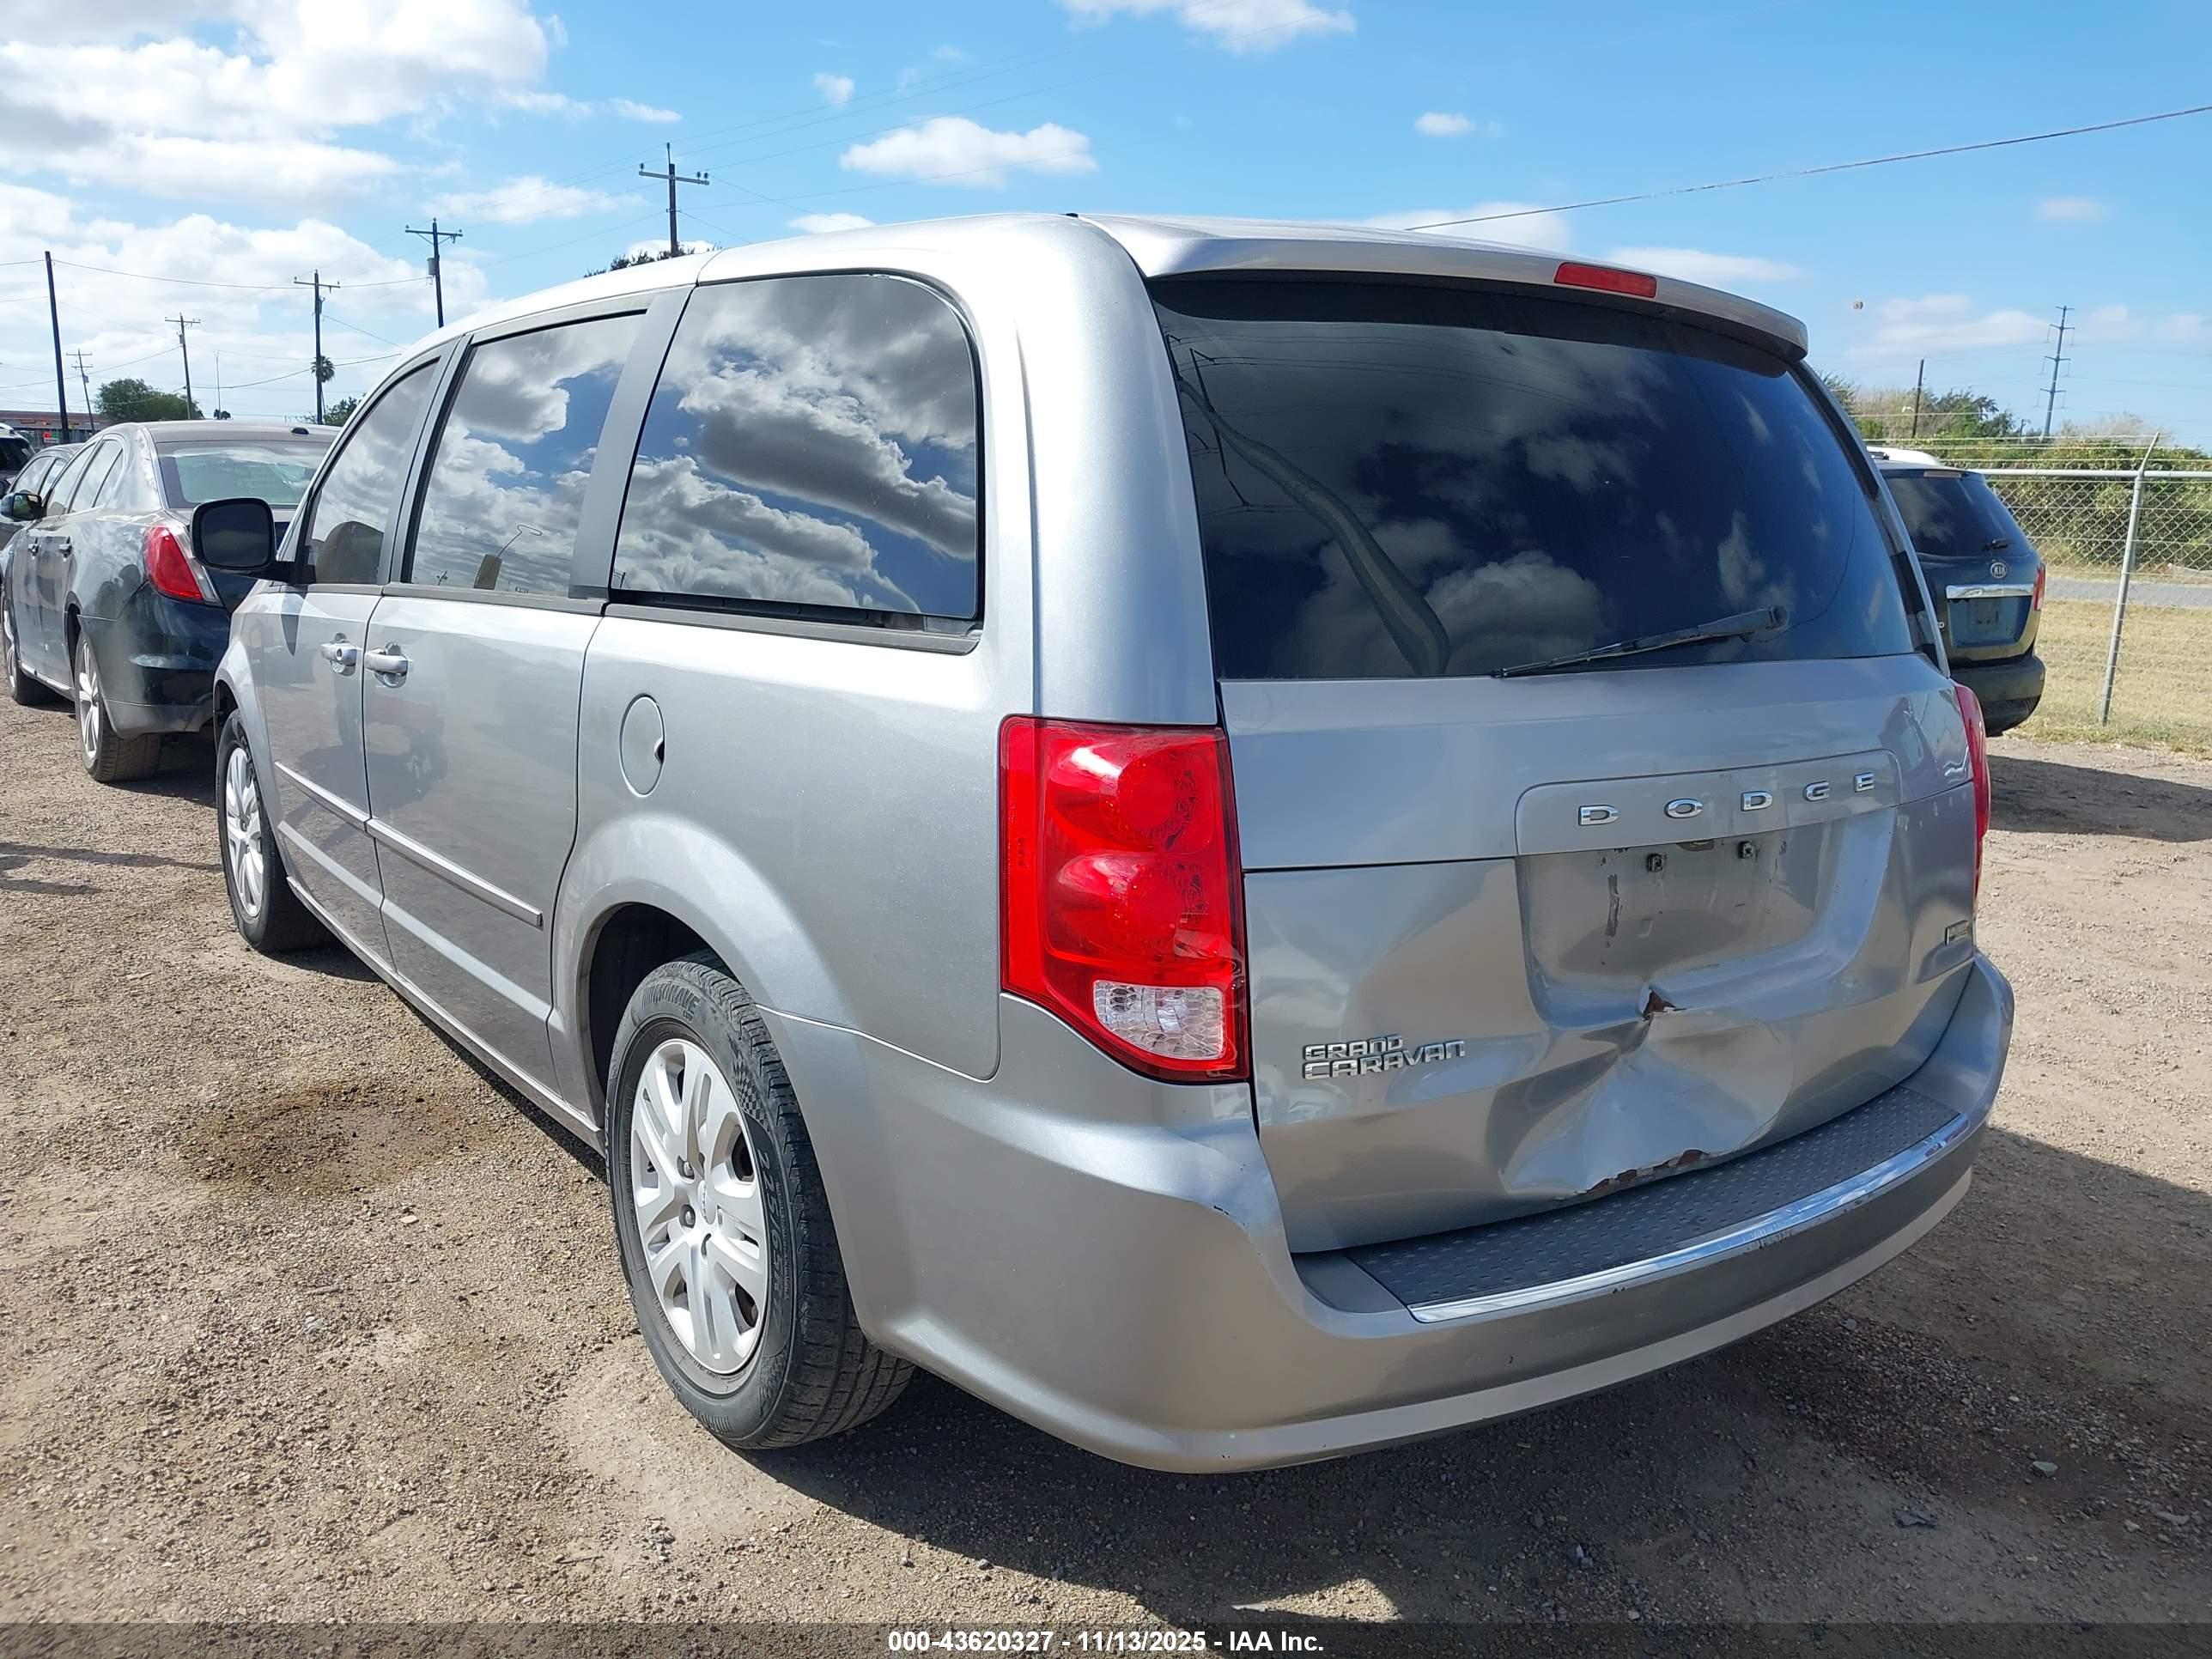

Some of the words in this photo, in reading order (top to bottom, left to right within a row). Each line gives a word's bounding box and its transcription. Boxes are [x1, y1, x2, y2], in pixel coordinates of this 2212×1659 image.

[1578, 772, 1875, 826] DODGE
[1304, 1034, 1404, 1060] GRAND
[1304, 1040, 1466, 1080] CARAVAN
